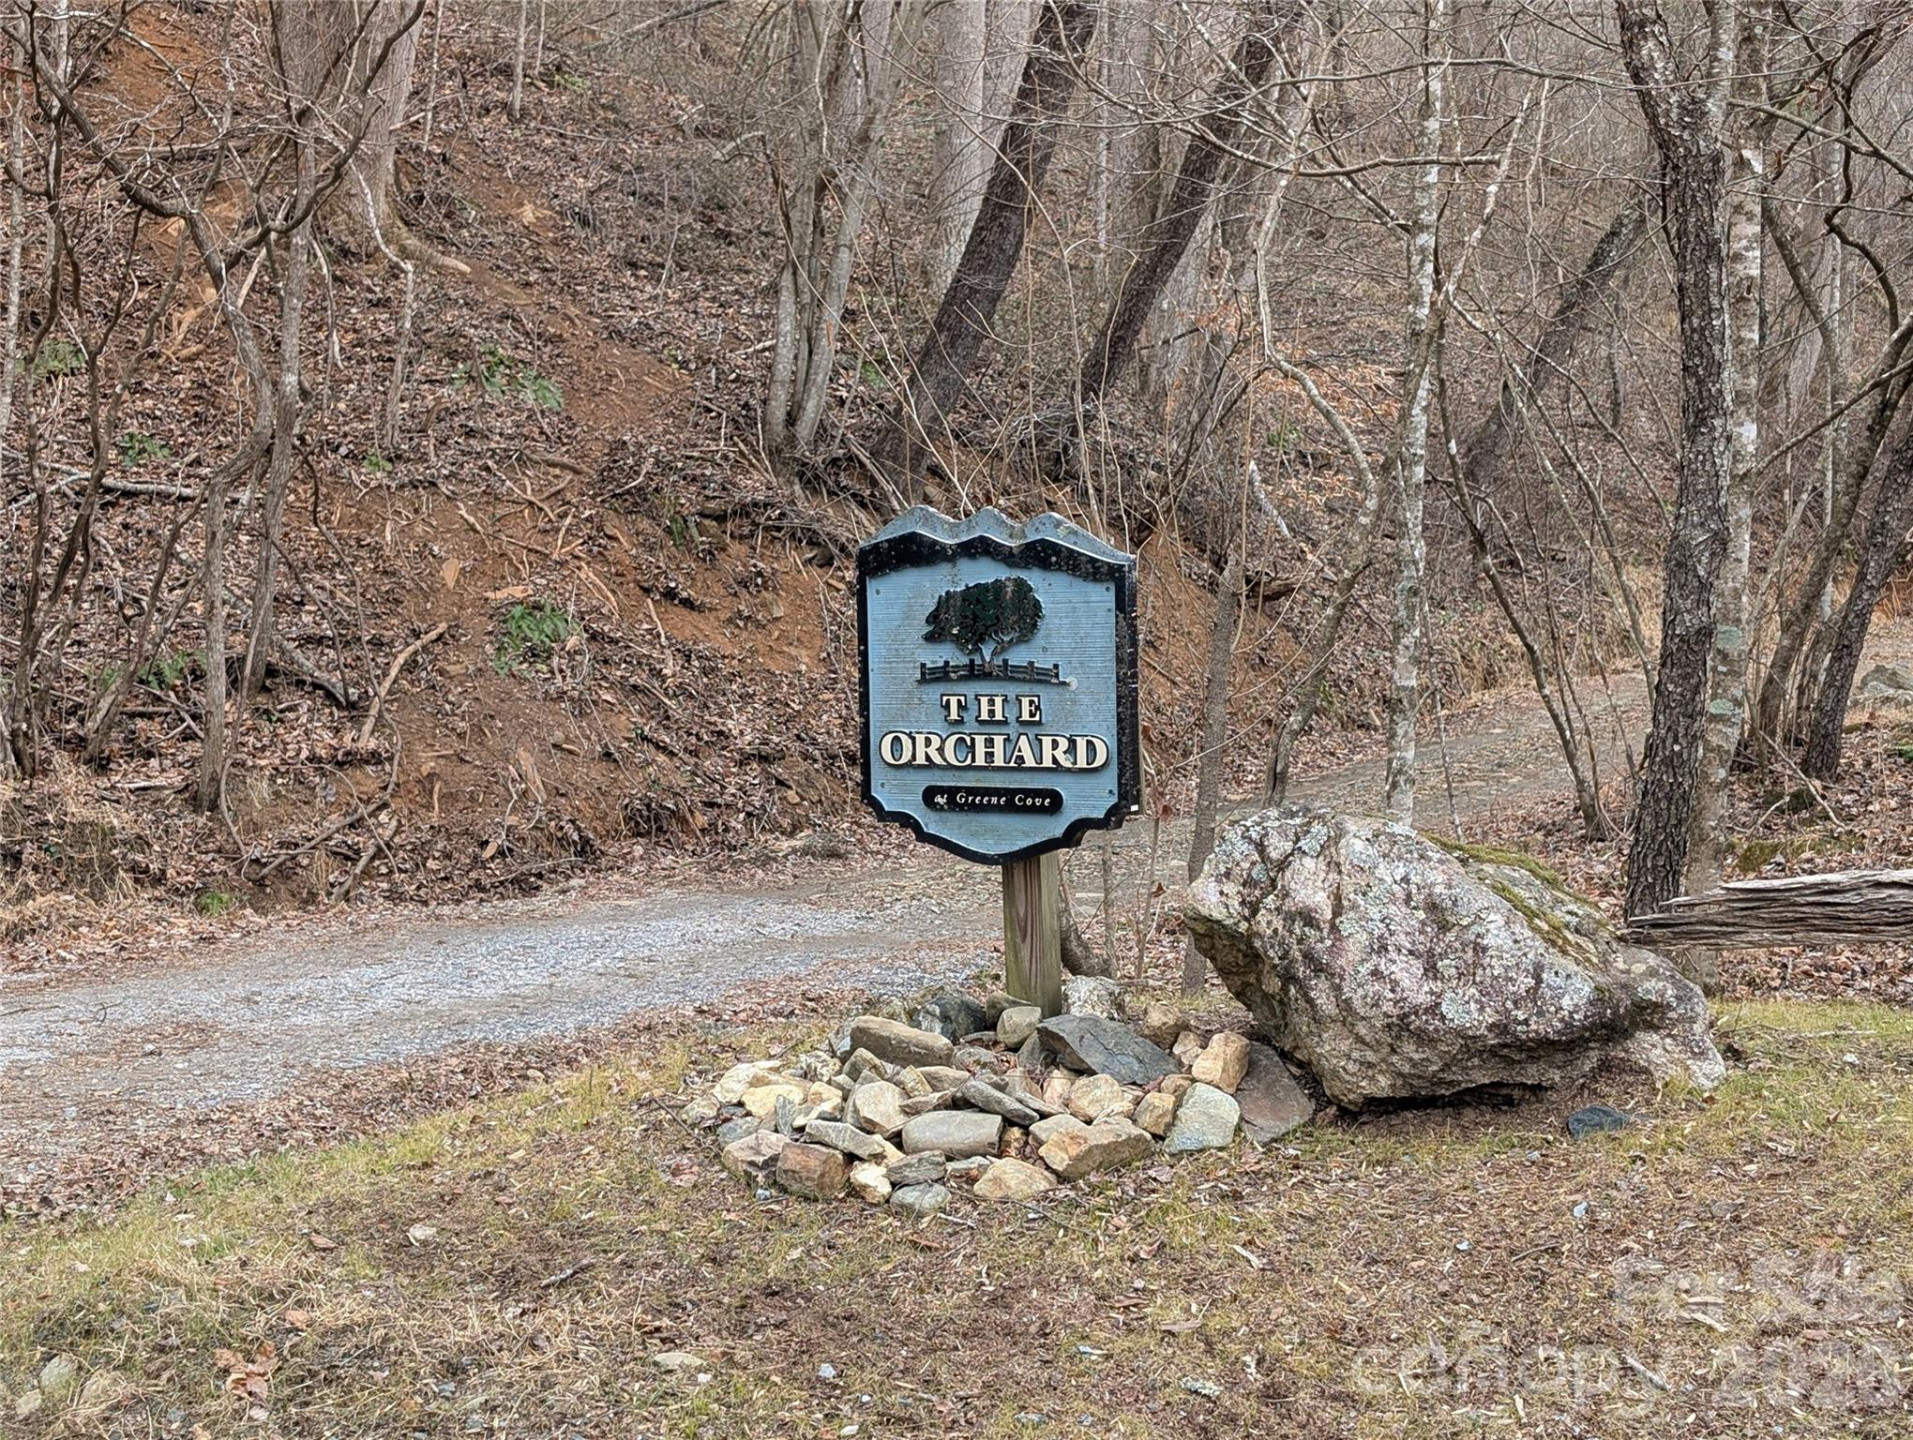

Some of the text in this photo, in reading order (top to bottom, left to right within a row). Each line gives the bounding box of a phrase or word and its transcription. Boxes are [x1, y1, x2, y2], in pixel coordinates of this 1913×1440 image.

[940, 694, 1042, 723] THE
[880, 731, 1109, 769] ORCHARD
[933, 792, 1051, 807] at Greene Cove
